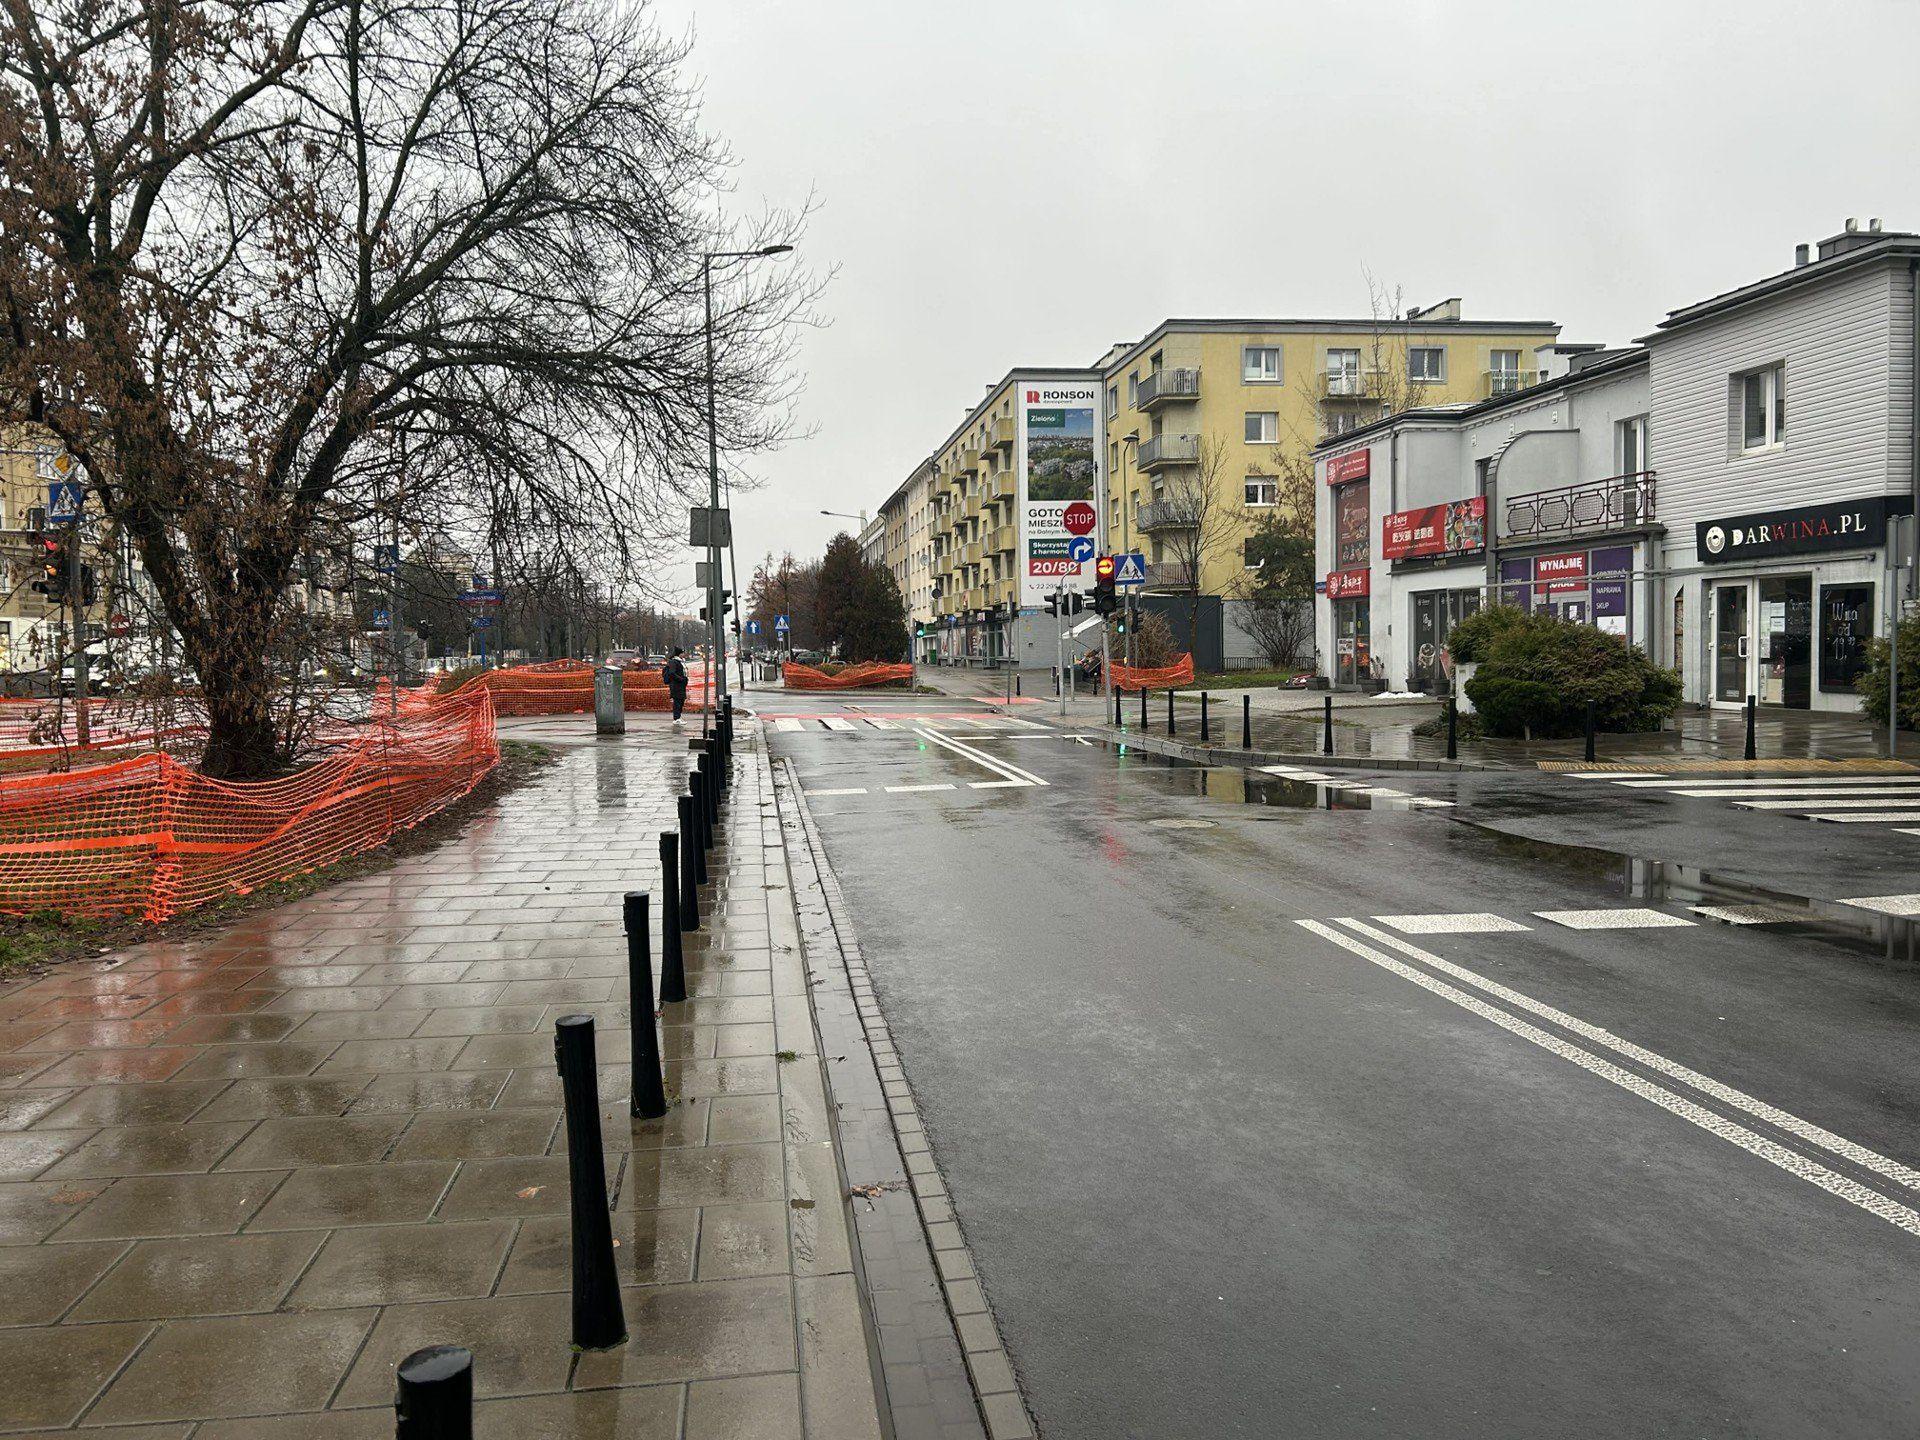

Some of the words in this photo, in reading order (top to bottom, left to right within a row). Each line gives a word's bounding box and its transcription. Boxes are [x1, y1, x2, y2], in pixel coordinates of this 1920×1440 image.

[1043, 391, 1094, 399] RONSON
[1066, 513, 1094, 525] STOP
[1732, 513, 1867, 546] DARWINA.PL
[1033, 561, 1078, 574] 20/80
[1540, 557, 1583, 571] WYNAJMĘ
[1596, 602, 1610, 610] SKUP
[1838, 622, 1851, 636] od
